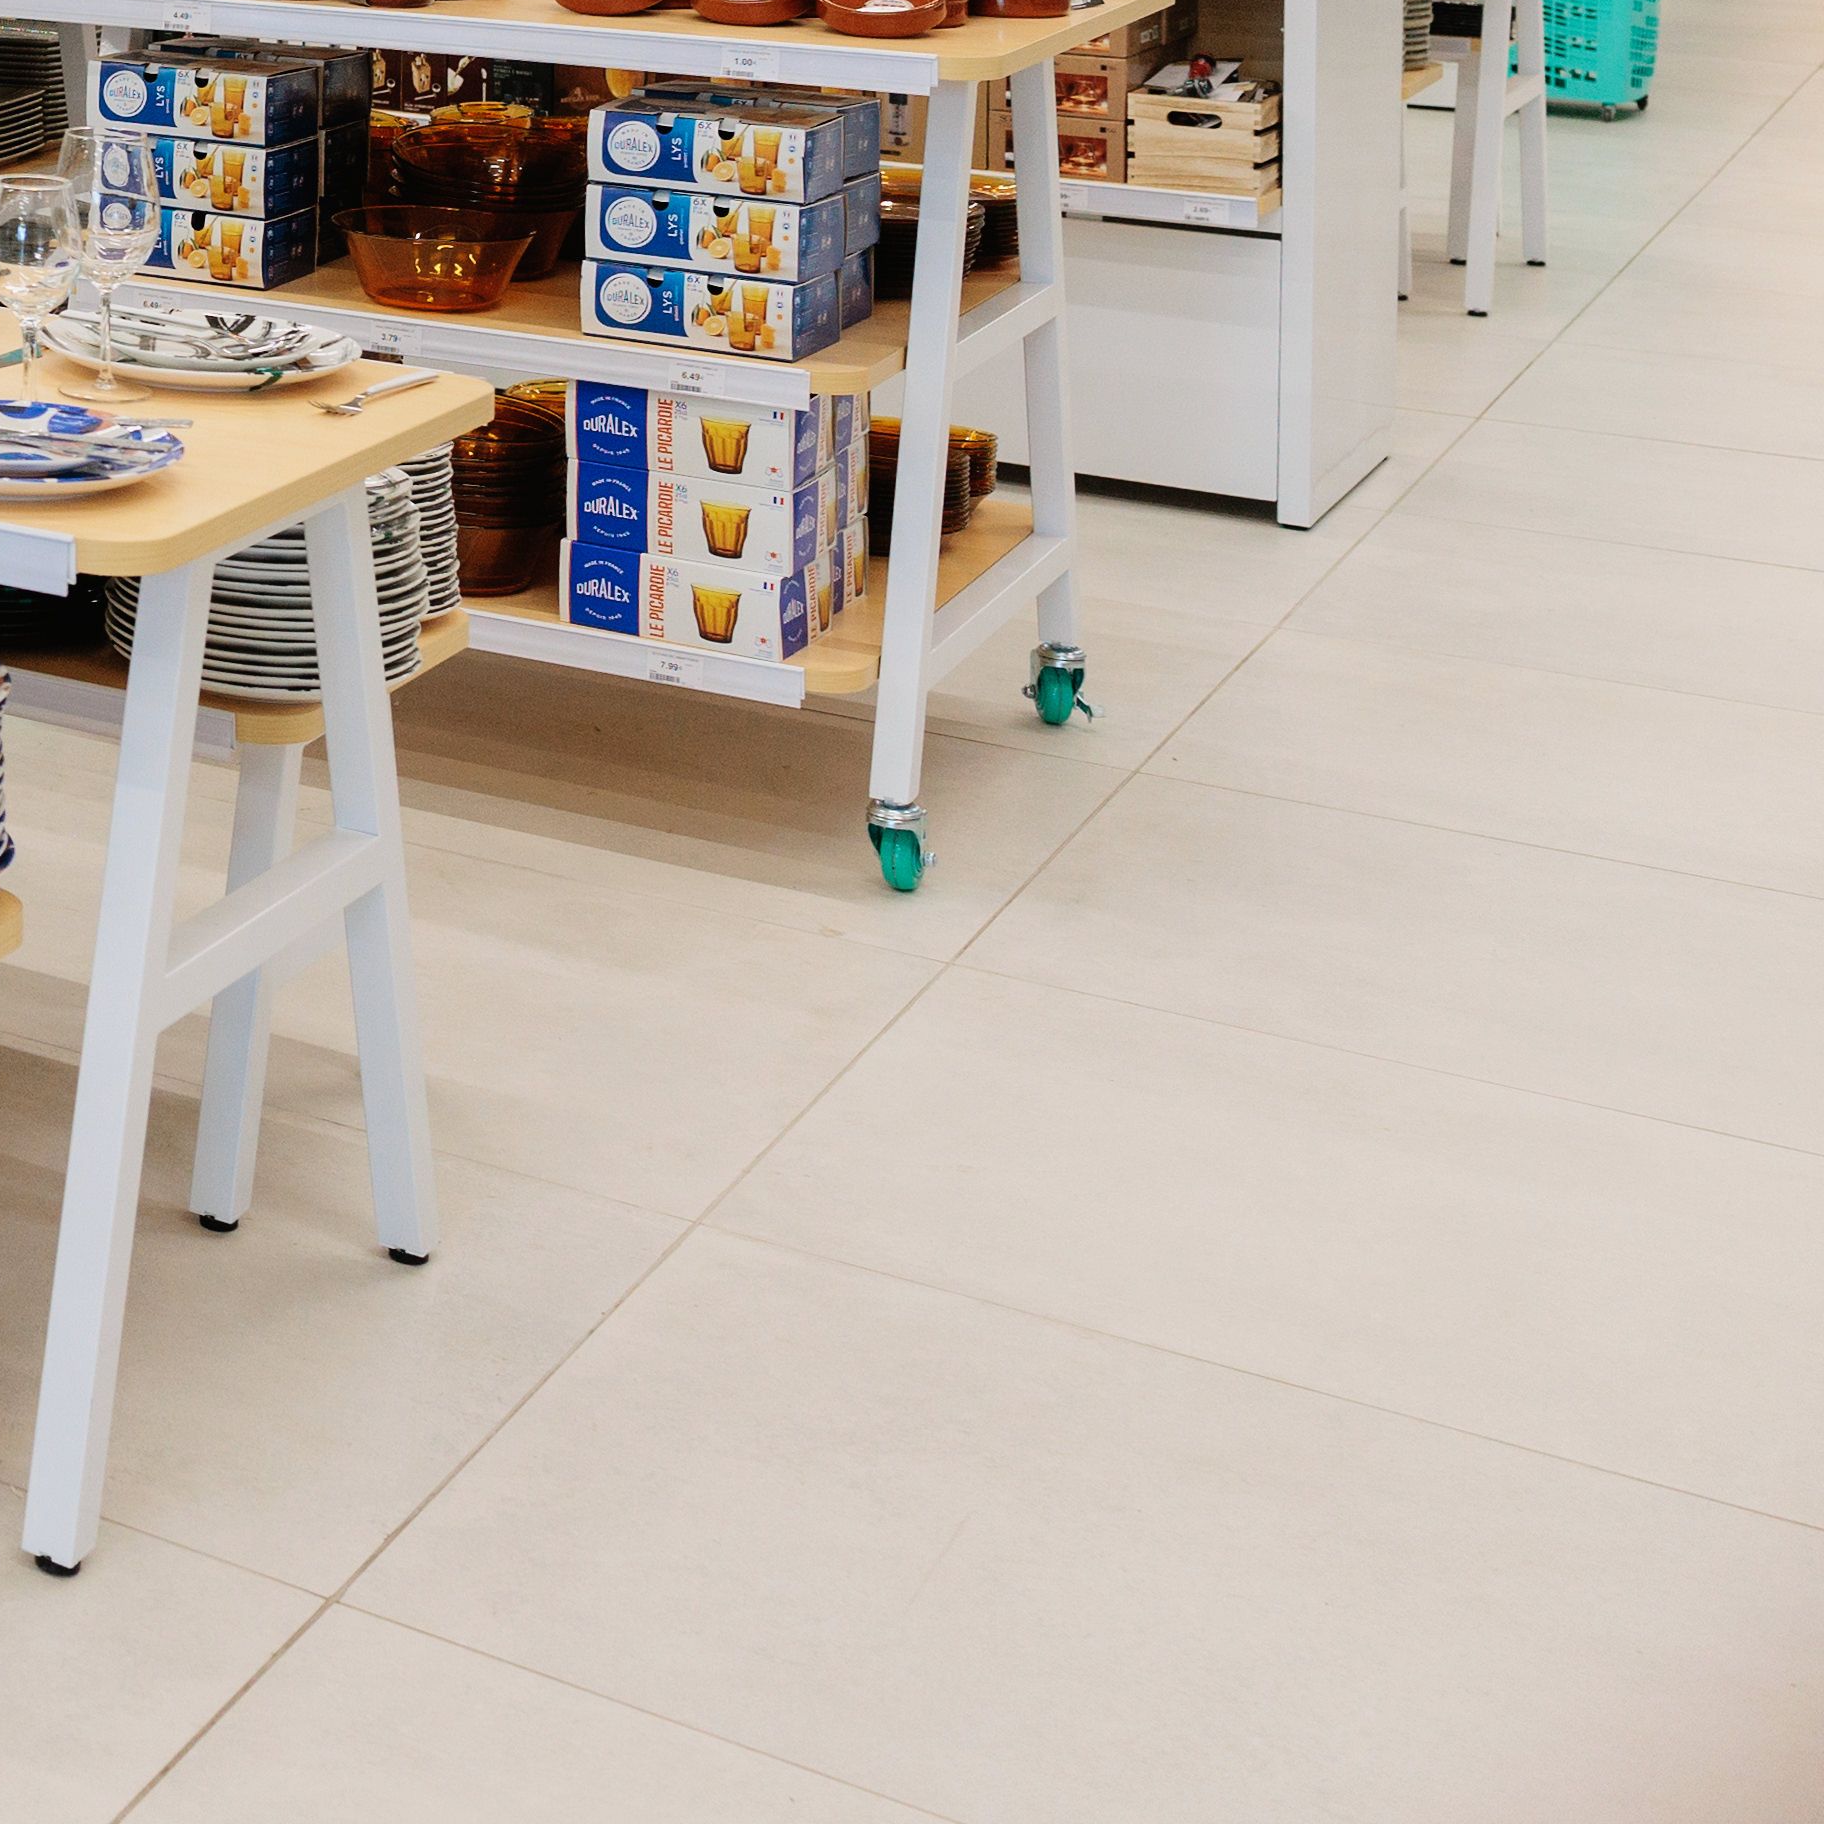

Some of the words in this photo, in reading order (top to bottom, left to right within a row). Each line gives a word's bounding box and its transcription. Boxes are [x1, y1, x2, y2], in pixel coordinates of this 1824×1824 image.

[155, 85, 165, 107] LYS
[697, 121, 712, 130] 6X
[614, 138, 653, 153] DURALEX
[672, 137, 682, 162] LYS
[155, 157, 164, 178] LYS
[693, 197, 707, 206] 6X
[612, 214, 649, 230] DURALEX
[668, 213, 679, 238] LYS
[687, 275, 701, 284] 6X
[606, 290, 645, 307] DURALEX
[662, 290, 673, 314] LYS
[590, 395, 605, 405] MADE
[612, 396, 632, 411] FRANCE
[675, 401, 687, 410] X6
[583, 413, 639, 438] DURALEX
[657, 398, 674, 454] PICARDIE
[657, 457, 673, 472] LE
[591, 478, 606, 487] MADE
[613, 479, 632, 493] FRANCE
[675, 484, 688, 493] X6
[583, 496, 639, 521] DURALEX
[657, 481, 674, 537] PICARDIE
[658, 539, 674, 555] LE
[583, 560, 598, 569] MADE
[604, 561, 625, 575] FRANCE
[666, 567, 679, 576] X6
[576, 578, 632, 604] DURALEX
[649, 564, 665, 620] PICARDIE
[649, 621, 664, 638] LE
